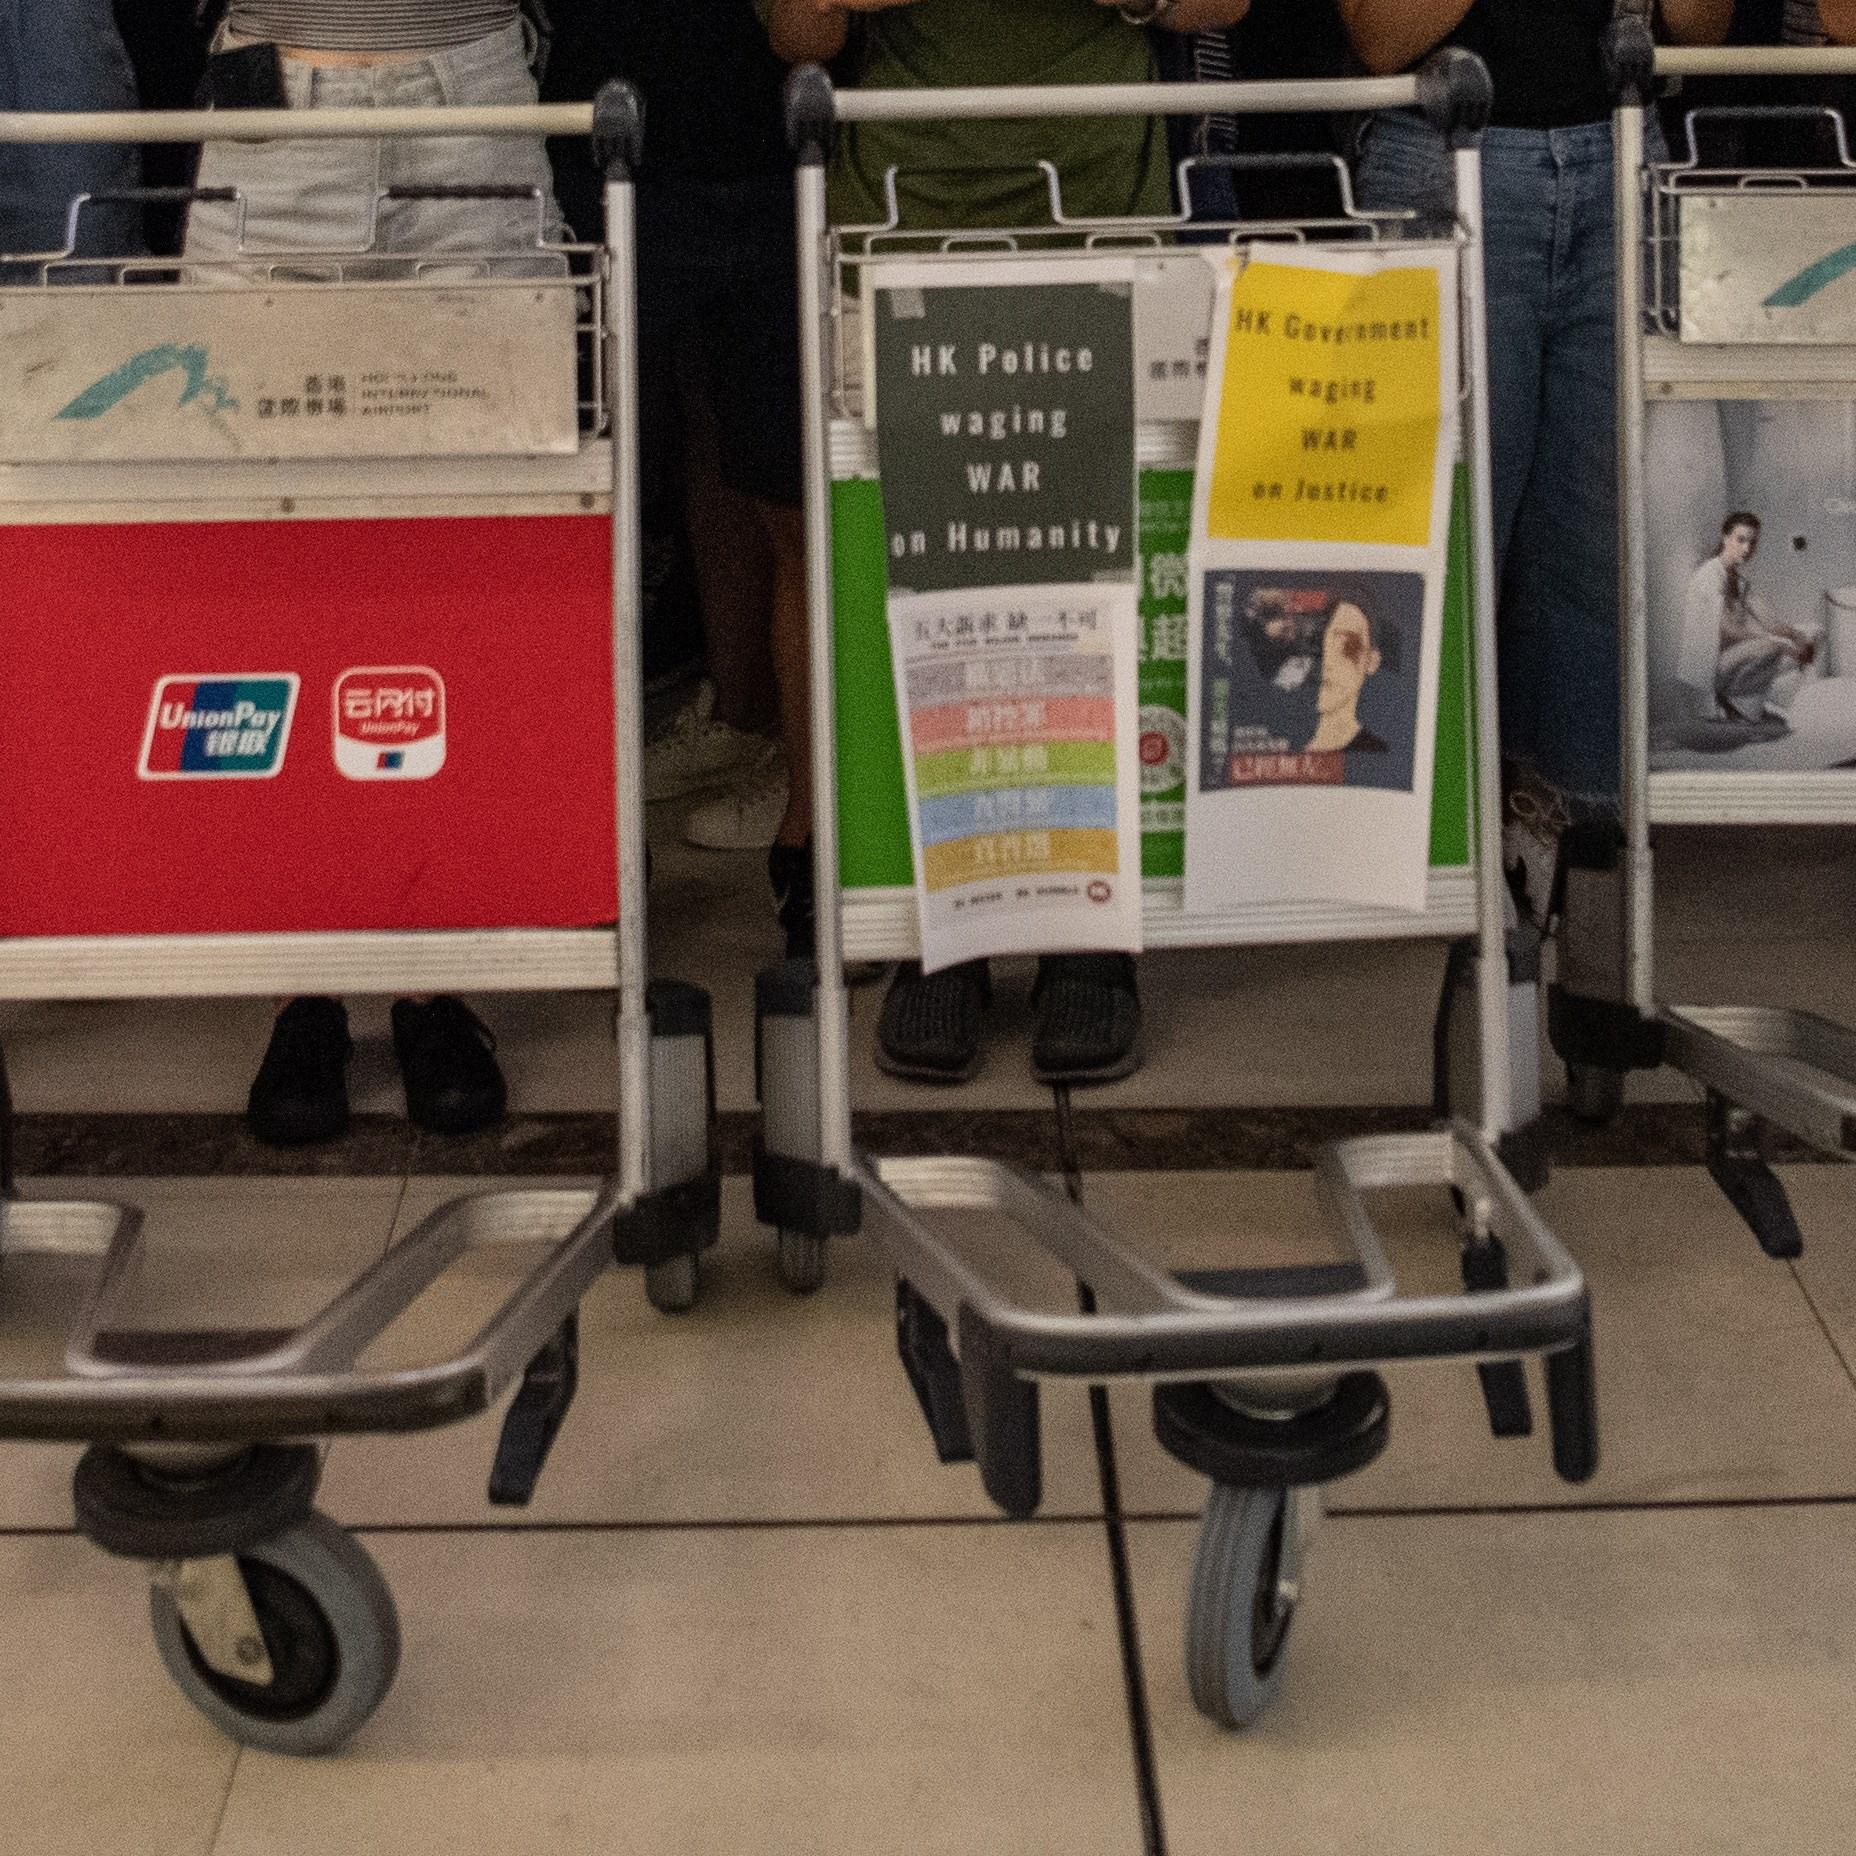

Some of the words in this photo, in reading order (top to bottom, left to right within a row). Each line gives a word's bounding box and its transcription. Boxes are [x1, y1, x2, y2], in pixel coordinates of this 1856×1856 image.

[1235, 309, 1272, 335] HK
[1283, 312, 1431, 344] Government
[910, 346, 957, 377] HK
[978, 343, 1095, 375] Police
[1288, 375, 1377, 403] waging
[940, 405, 1069, 440] waging
[1300, 428, 1358, 453] WAR
[966, 462, 1042, 493] WAR
[1252, 479, 1283, 502] on
[1293, 478, 1390, 505] Justice
[891, 531, 928, 558] on
[947, 522, 1123, 556] Humanity
[160, 701, 282, 735] UnionPay
[359, 721, 420, 736] UnionPay
